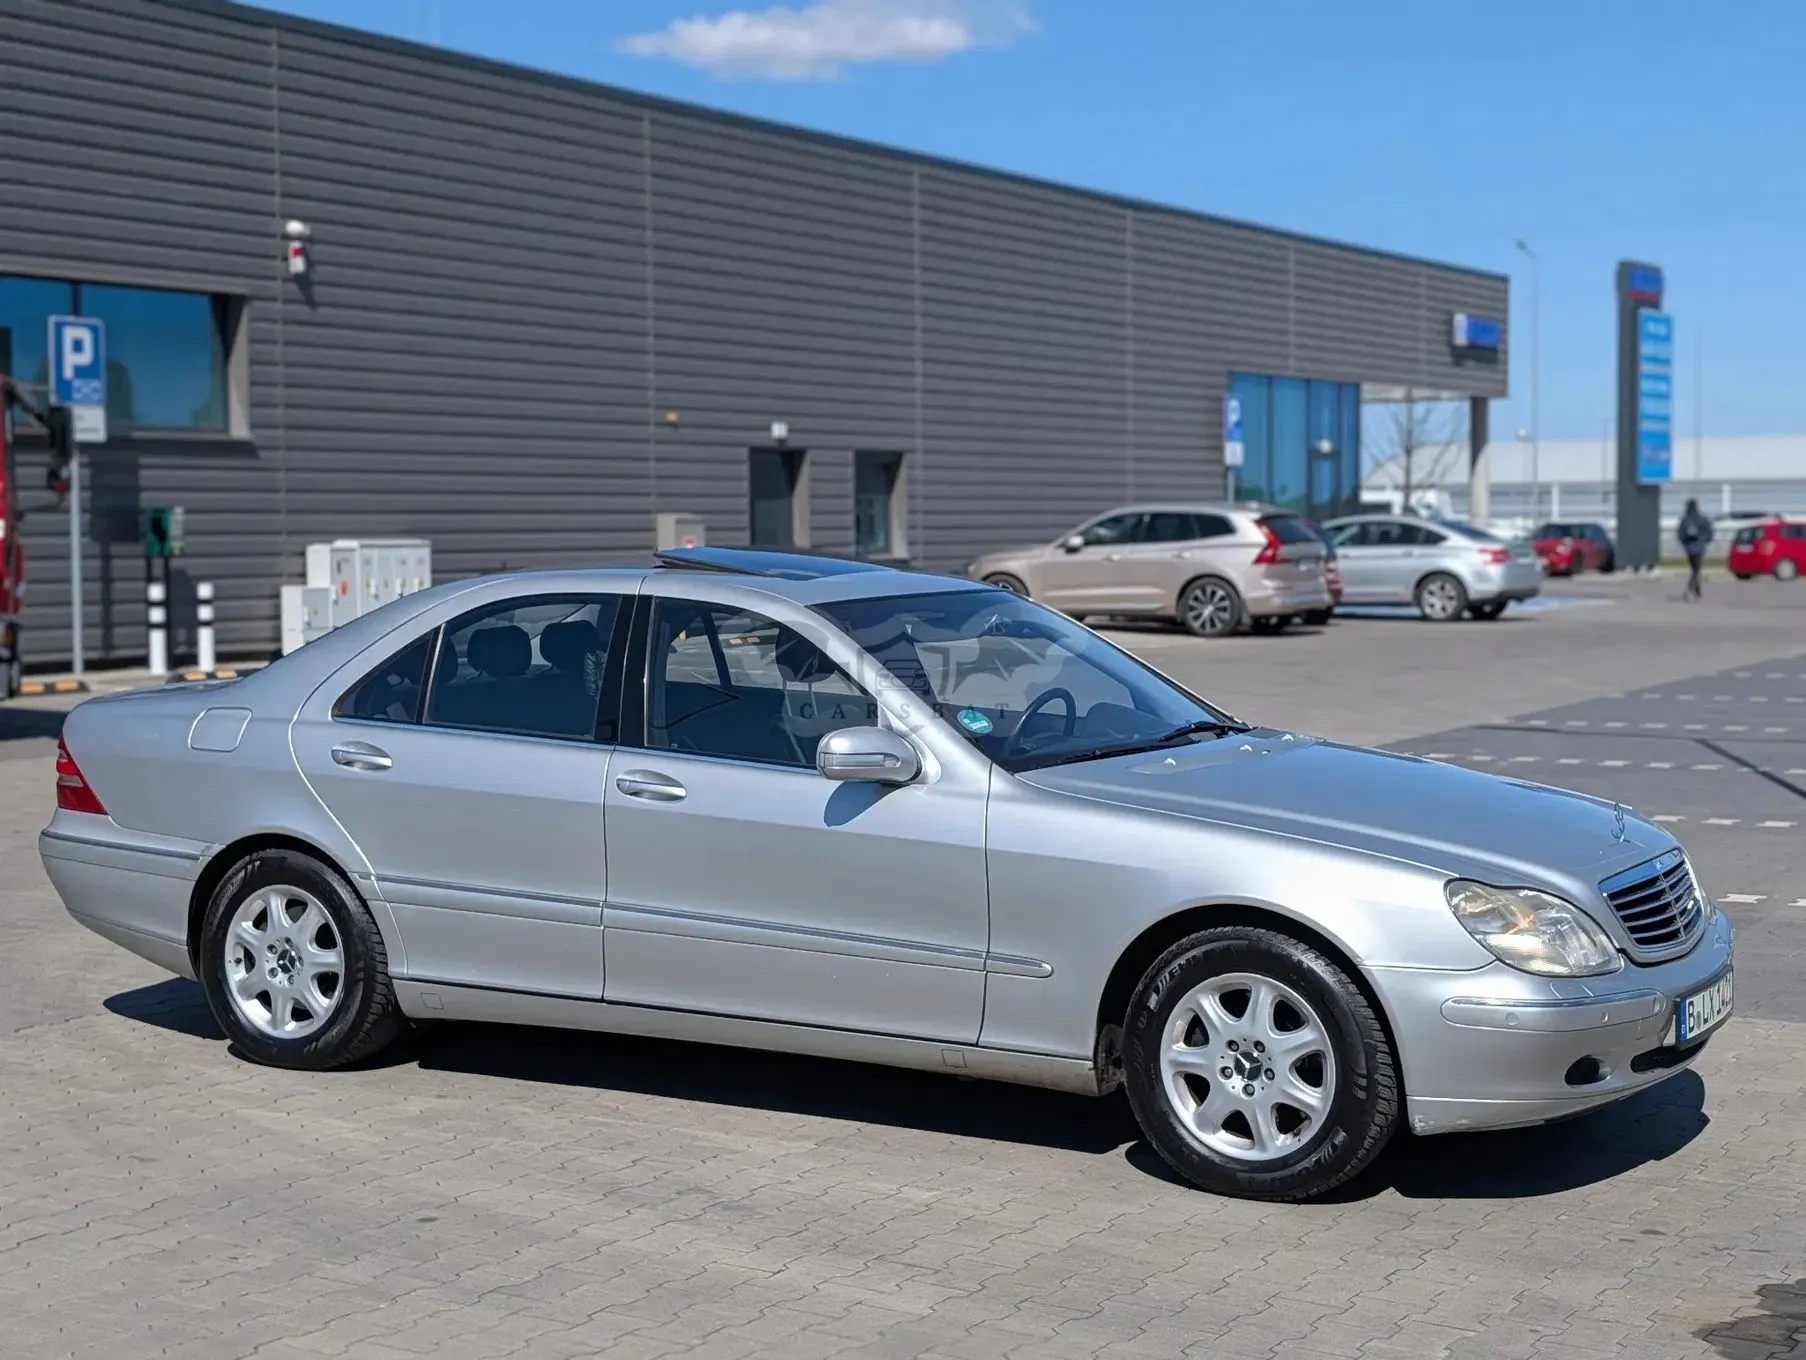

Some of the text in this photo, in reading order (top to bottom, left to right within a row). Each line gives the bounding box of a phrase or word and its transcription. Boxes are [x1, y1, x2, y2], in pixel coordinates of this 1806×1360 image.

[62, 325, 94, 380] P
[1687, 1000, 1696, 1034] B
[1702, 988, 1716, 1025] LX
